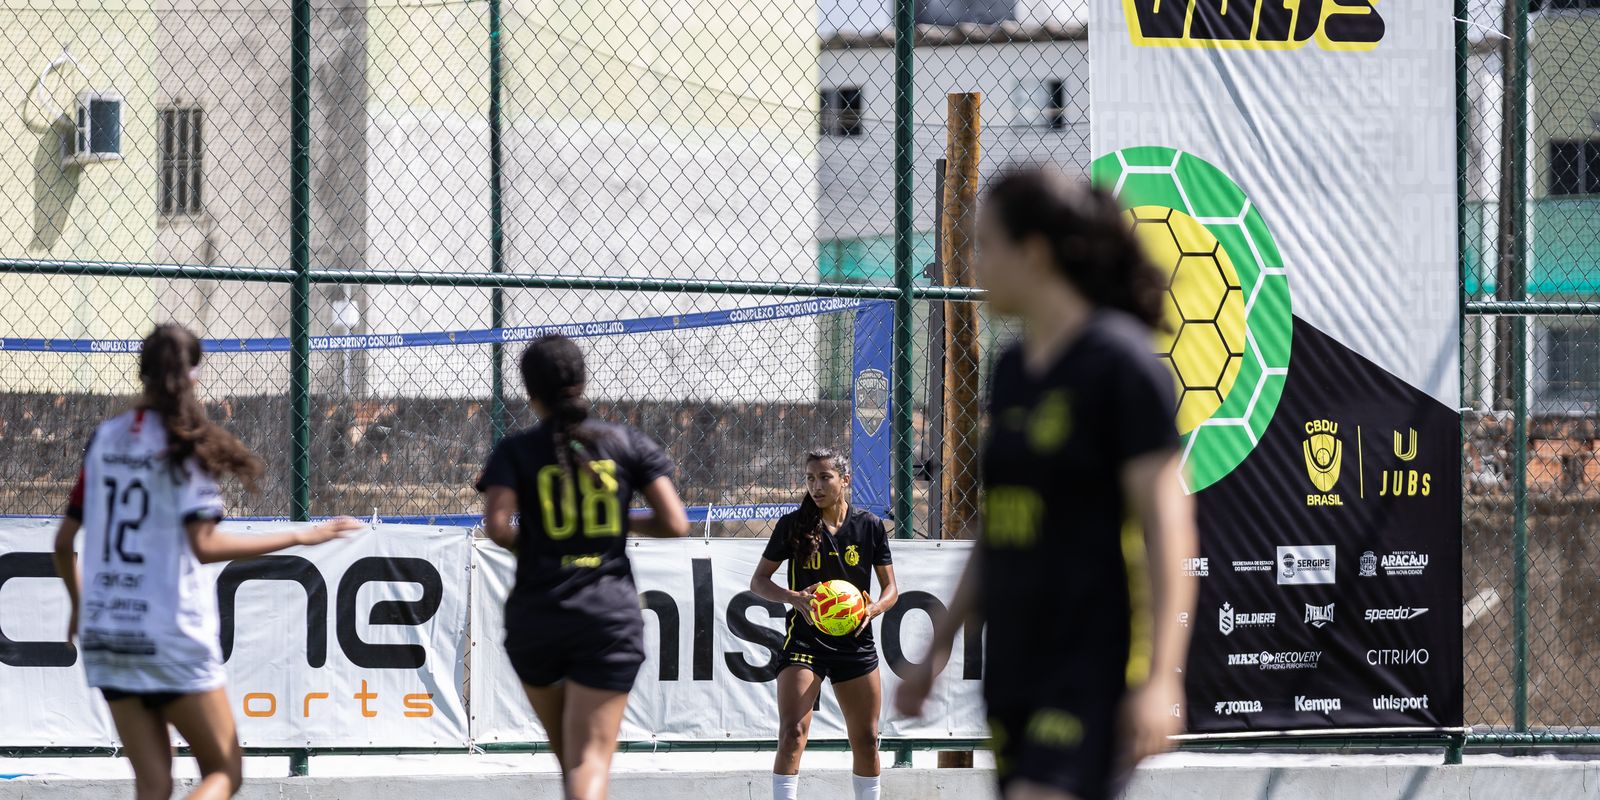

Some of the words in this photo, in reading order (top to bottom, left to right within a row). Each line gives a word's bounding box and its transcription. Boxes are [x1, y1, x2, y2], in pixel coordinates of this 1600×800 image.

[729, 307, 773, 322] COMPLEXO
[775, 301, 818, 317] ESPORTIVO
[502, 327, 544, 341] COMPLEXO
[544, 324, 584, 337] ESPORTIVO
[90, 340, 127, 352] COMPLEXO
[329, 336, 367, 349] ESPORTIVO
[1305, 419, 1339, 434] CBDU
[537, 459, 623, 540] 08
[1306, 494, 1344, 506] BRASIL
[102, 475, 149, 564] 12
[710, 507, 753, 520] COMPLEXO
[1297, 558, 1330, 568] SERGIPE
[1380, 554, 1429, 567] ARACAJU
[1235, 612, 1276, 624] SOLDIERS
[1304, 602, 1335, 624] EVERLAST
[1364, 606, 1409, 623] speedo
[1228, 653, 1260, 665] MAX
[1273, 651, 1322, 663] RECOVERY
[1285, 661, 1318, 669] PERFORMANCE
[1294, 695, 1341, 714] Kempa
[1373, 694, 1428, 713] uhlsport
